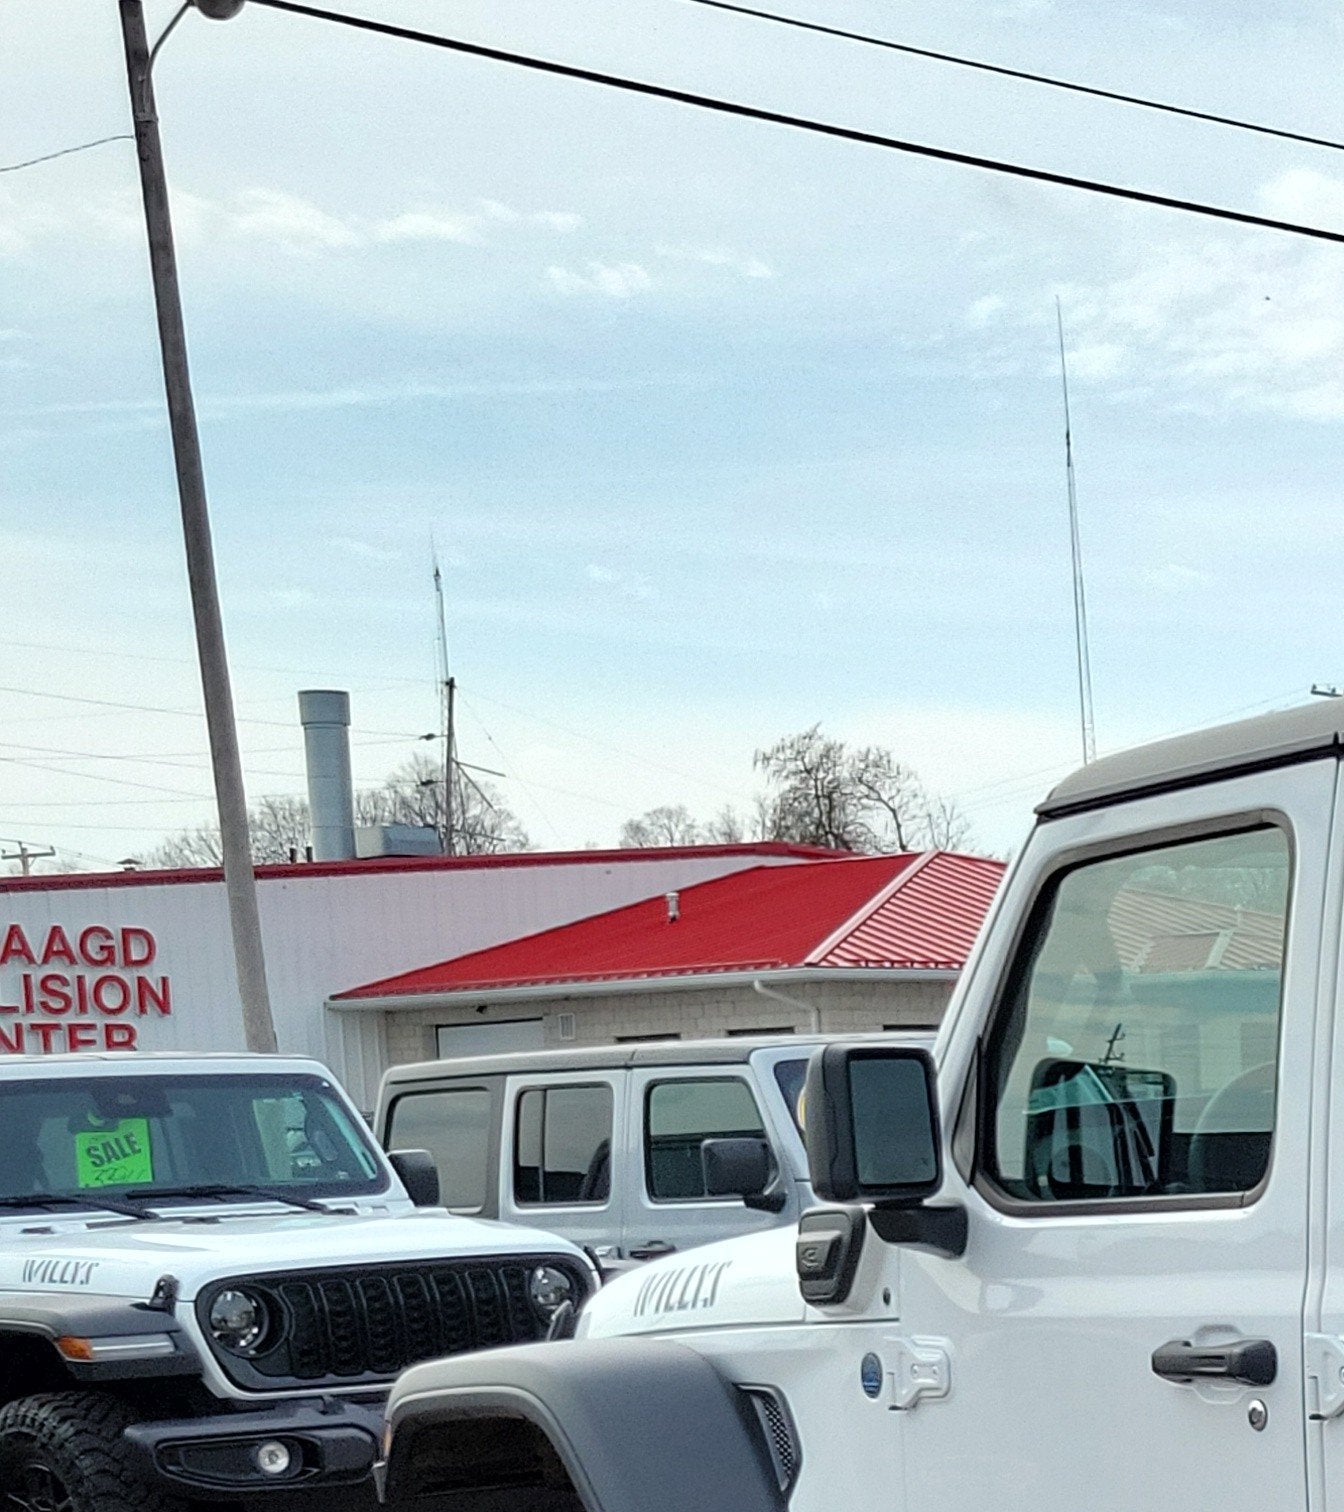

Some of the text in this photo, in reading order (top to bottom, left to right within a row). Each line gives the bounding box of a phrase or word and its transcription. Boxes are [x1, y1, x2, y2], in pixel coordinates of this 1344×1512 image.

[0, 923, 157, 968] AAGD
[86, 1131, 142, 1168] SALE
[22, 1258, 100, 1285] WILLYS
